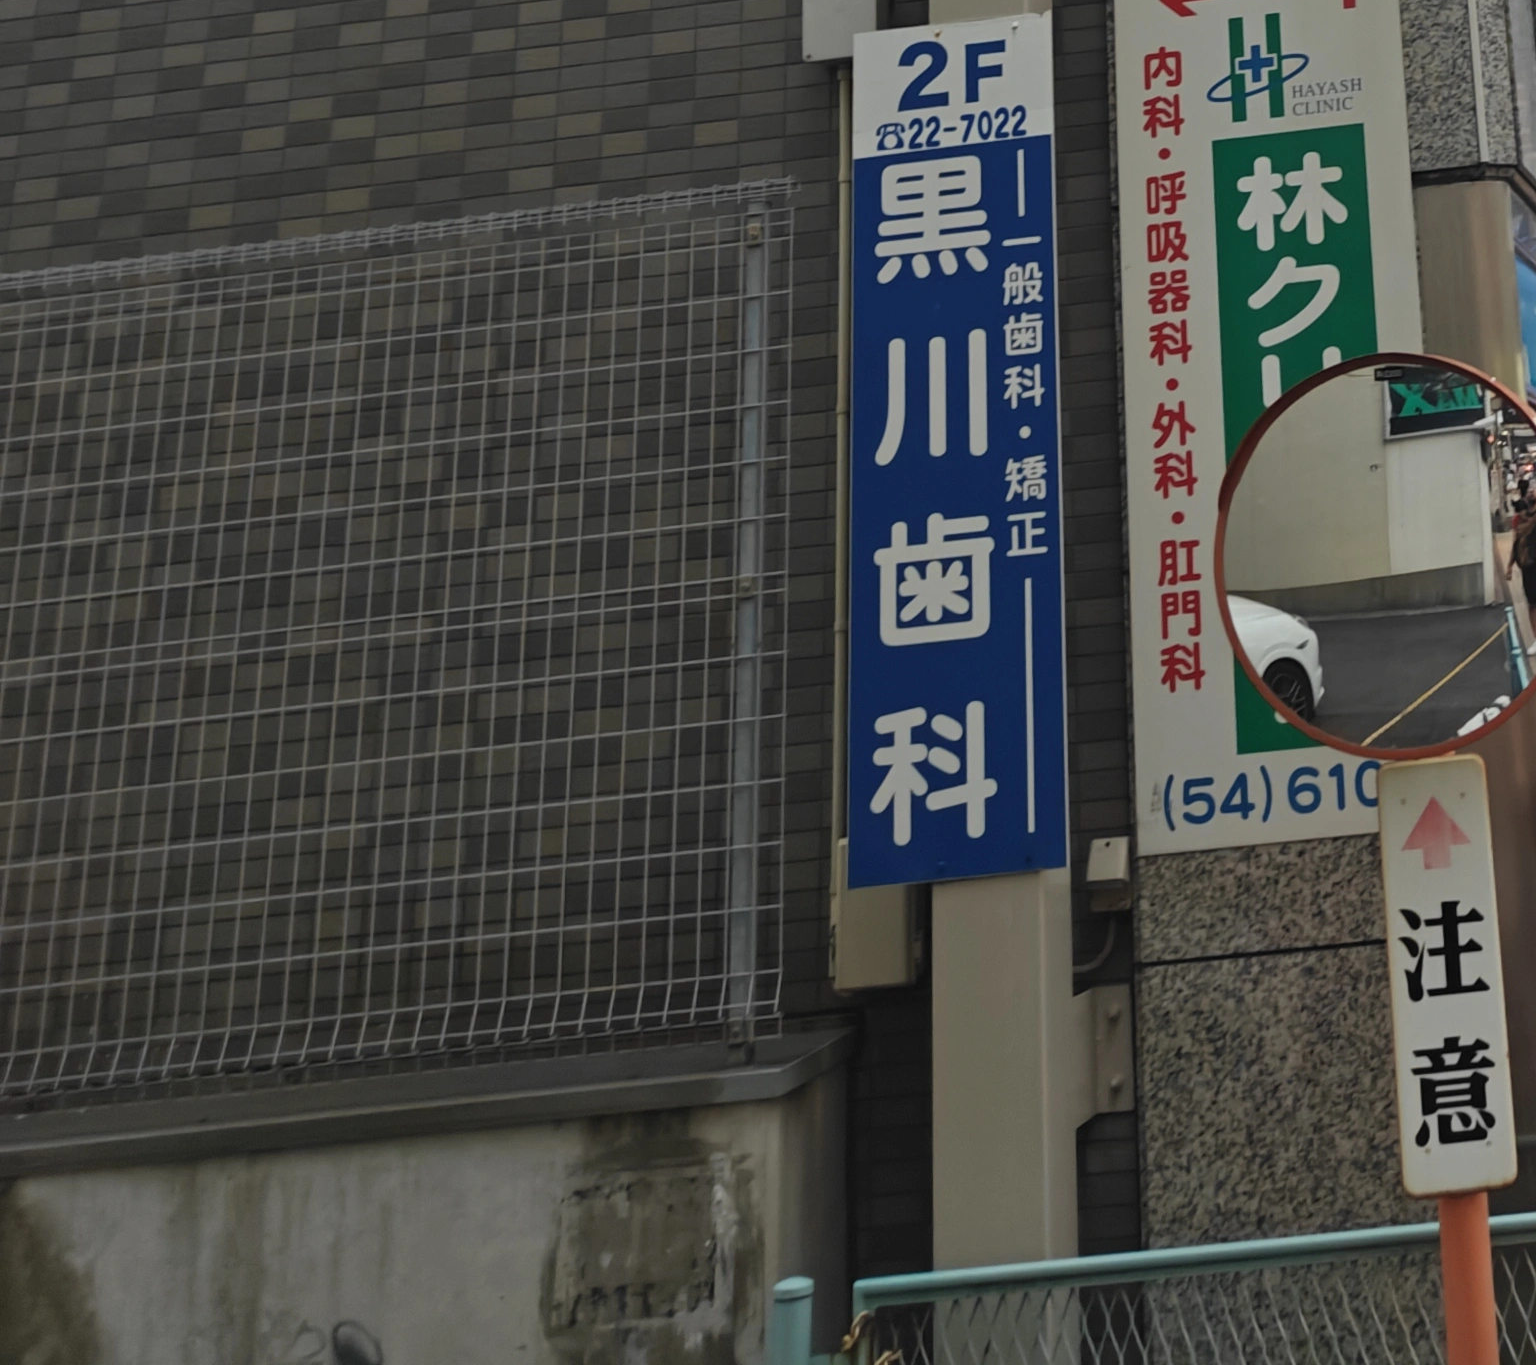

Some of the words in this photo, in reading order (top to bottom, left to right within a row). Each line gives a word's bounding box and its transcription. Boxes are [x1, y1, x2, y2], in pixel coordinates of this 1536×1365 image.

[897, 40, 1007, 112] 2F
[1292, 96, 1354, 117] CLINIC
[869, 155, 998, 847] 黒川歯科
[1002, 235, 1049, 558] 一般歯科・矯正
[1142, 47, 1206, 693] 内科・呼吸器科・外科・肛門科
[1398, 900, 1498, 1148] 注意
